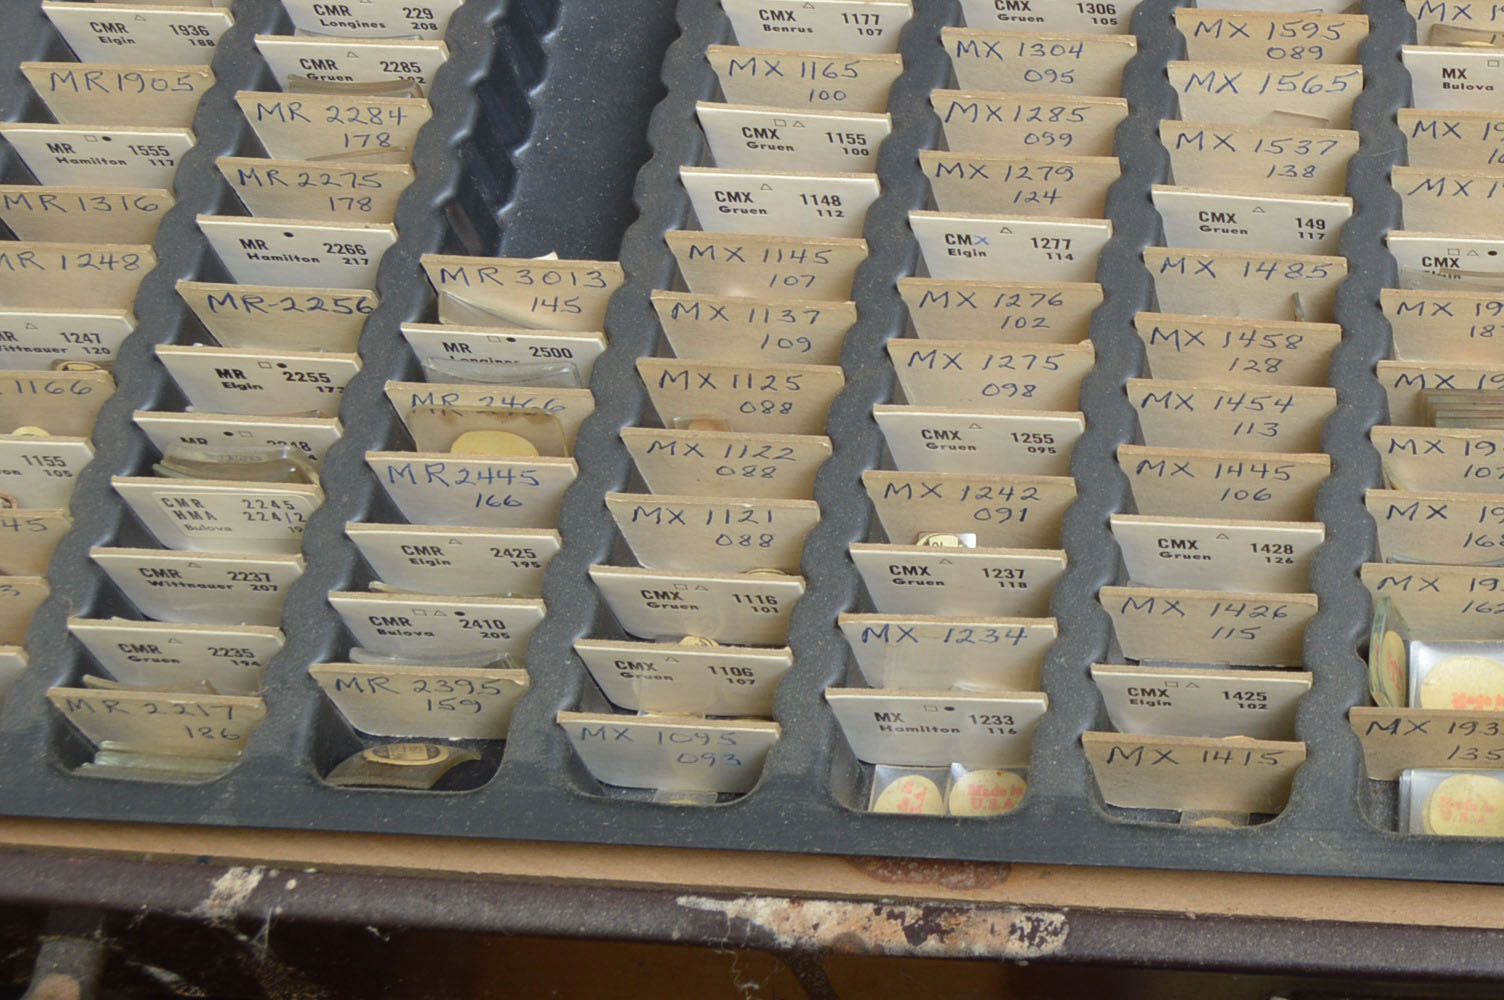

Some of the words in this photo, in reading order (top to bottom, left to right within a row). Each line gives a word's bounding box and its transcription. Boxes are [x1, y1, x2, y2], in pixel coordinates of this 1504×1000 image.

[313, 4, 352, 16] CMR
[403, 7, 434, 19] 229
[759, 9, 796, 21] CMX
[842, 13, 879, 25] 1177
[320, 19, 386, 29] Longines
[411, 22, 438, 30] 208
[763, 24, 813, 33] Benrus
[857, 28, 882, 36] 107
[957, 40, 1003, 61] MX
[1019, 39, 1083, 59] 1304
[1024, 69, 1074, 84] 095
[1442, 68, 1467, 79] MX
[1443, 82, 1493, 91] Bulova
[257, 102, 311, 122] MR
[326, 105, 407, 126] 2284
[344, 132, 391, 148] 178
[46, 143, 76, 153] MR
[128, 145, 170, 156] 1555
[56, 157, 127, 165] Hamilton
[239, 239, 268, 250] MR
[323, 243, 366, 255] 2266
[247, 253, 320, 263] Hamilton
[1397, 301, 1453, 317] MX
[921, 429, 962, 440] CMX
[1011, 433, 1054, 444] 1255
[646, 440, 704, 457] MX
[724, 444, 796, 461] 1122
[926, 442, 976, 450] Gruen
[716, 465, 776, 478] 088
[139, 568, 182, 578] CMR
[227, 571, 270, 582] 2237
[147, 580, 233, 589] Wittnauer
[335, 675, 399, 694] MR
[413, 676, 505, 695] 2395
[427, 697, 481, 713] 159
[1106, 746, 1179, 766] MX
[1203, 747, 1285, 766] 1415
